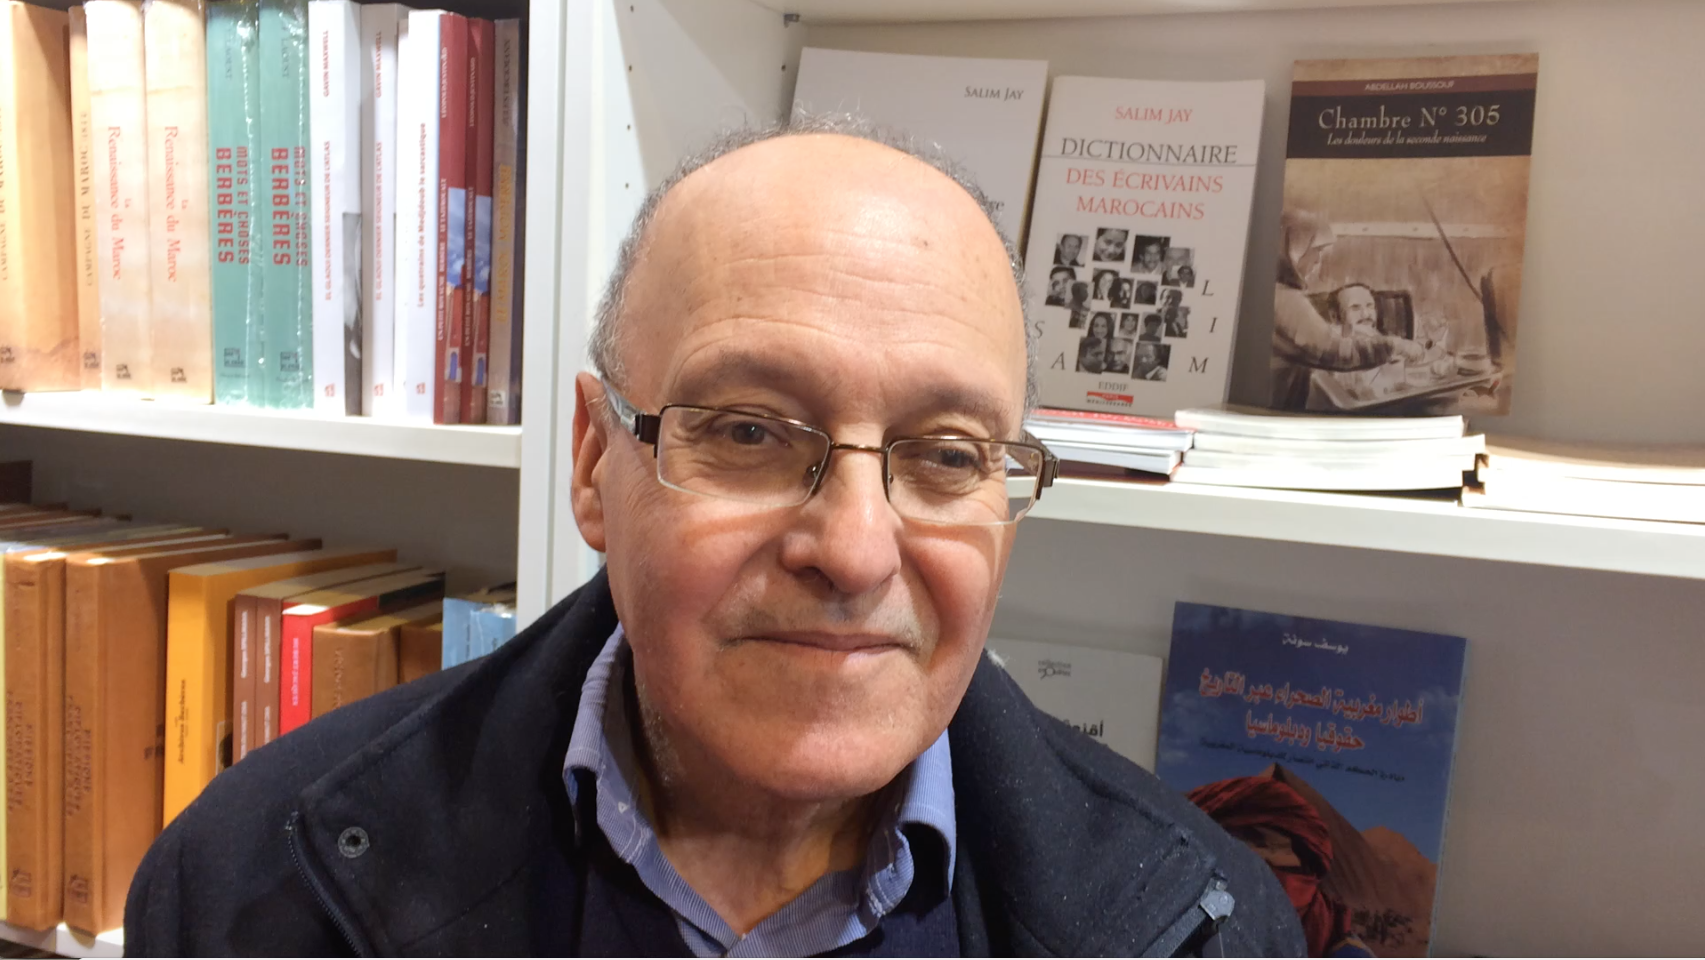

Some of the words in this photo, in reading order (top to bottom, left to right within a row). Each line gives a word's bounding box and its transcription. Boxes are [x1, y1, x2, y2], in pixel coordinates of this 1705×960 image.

[1364, 82, 1408, 92] ABDELLAH
[1115, 106, 1162, 121] SALIM
[1164, 109, 1193, 125] JAY
[1318, 105, 1412, 129] Chambre
[1419, 107, 1448, 128] N°
[1455, 104, 1501, 126] 305
[1327, 132, 1343, 146] Les
[1344, 131, 1382, 146] douleurs
[1382, 130, 1395, 144] de
[1396, 129, 1407, 143] la
[1406, 129, 1442, 144] seconde
[1442, 132, 1488, 144] naissance
[1061, 137, 1238, 165] DICTIONNAIRE
[108, 126, 122, 209] Renaissance
[165, 126, 179, 210] Renaissance
[236, 146, 248, 185] MOTS
[1066, 168, 1105, 187] DES
[1112, 169, 1223, 194] ÉCRIVAINS
[216, 148, 237, 263] BERBÈRES
[237, 191, 248, 206] ET
[272, 148, 294, 265] BERBÈRES
[295, 191, 306, 206] ET
[1076, 196, 1205, 221] MAROCAINS
[111, 214, 123, 231] du
[166, 215, 179, 232] du
[238, 211, 250, 265] CHOSES
[417, 235, 425, 246] de
[112, 237, 125, 281] Maroc
[167, 239, 181, 282] Maroc
[1201, 280, 1215, 297] L
[1051, 352, 1066, 371] A
[1188, 357, 1209, 374] M
[1198, 668, 1245, 698] التاريخ
[1244, 683, 1274, 706] عبر
[1275, 683, 1332, 710] الصحراء
[1333, 689, 1384, 721] مغربية
[1380, 698, 1425, 729] أطوار
[1316, 721, 1365, 753] حقوقيا
